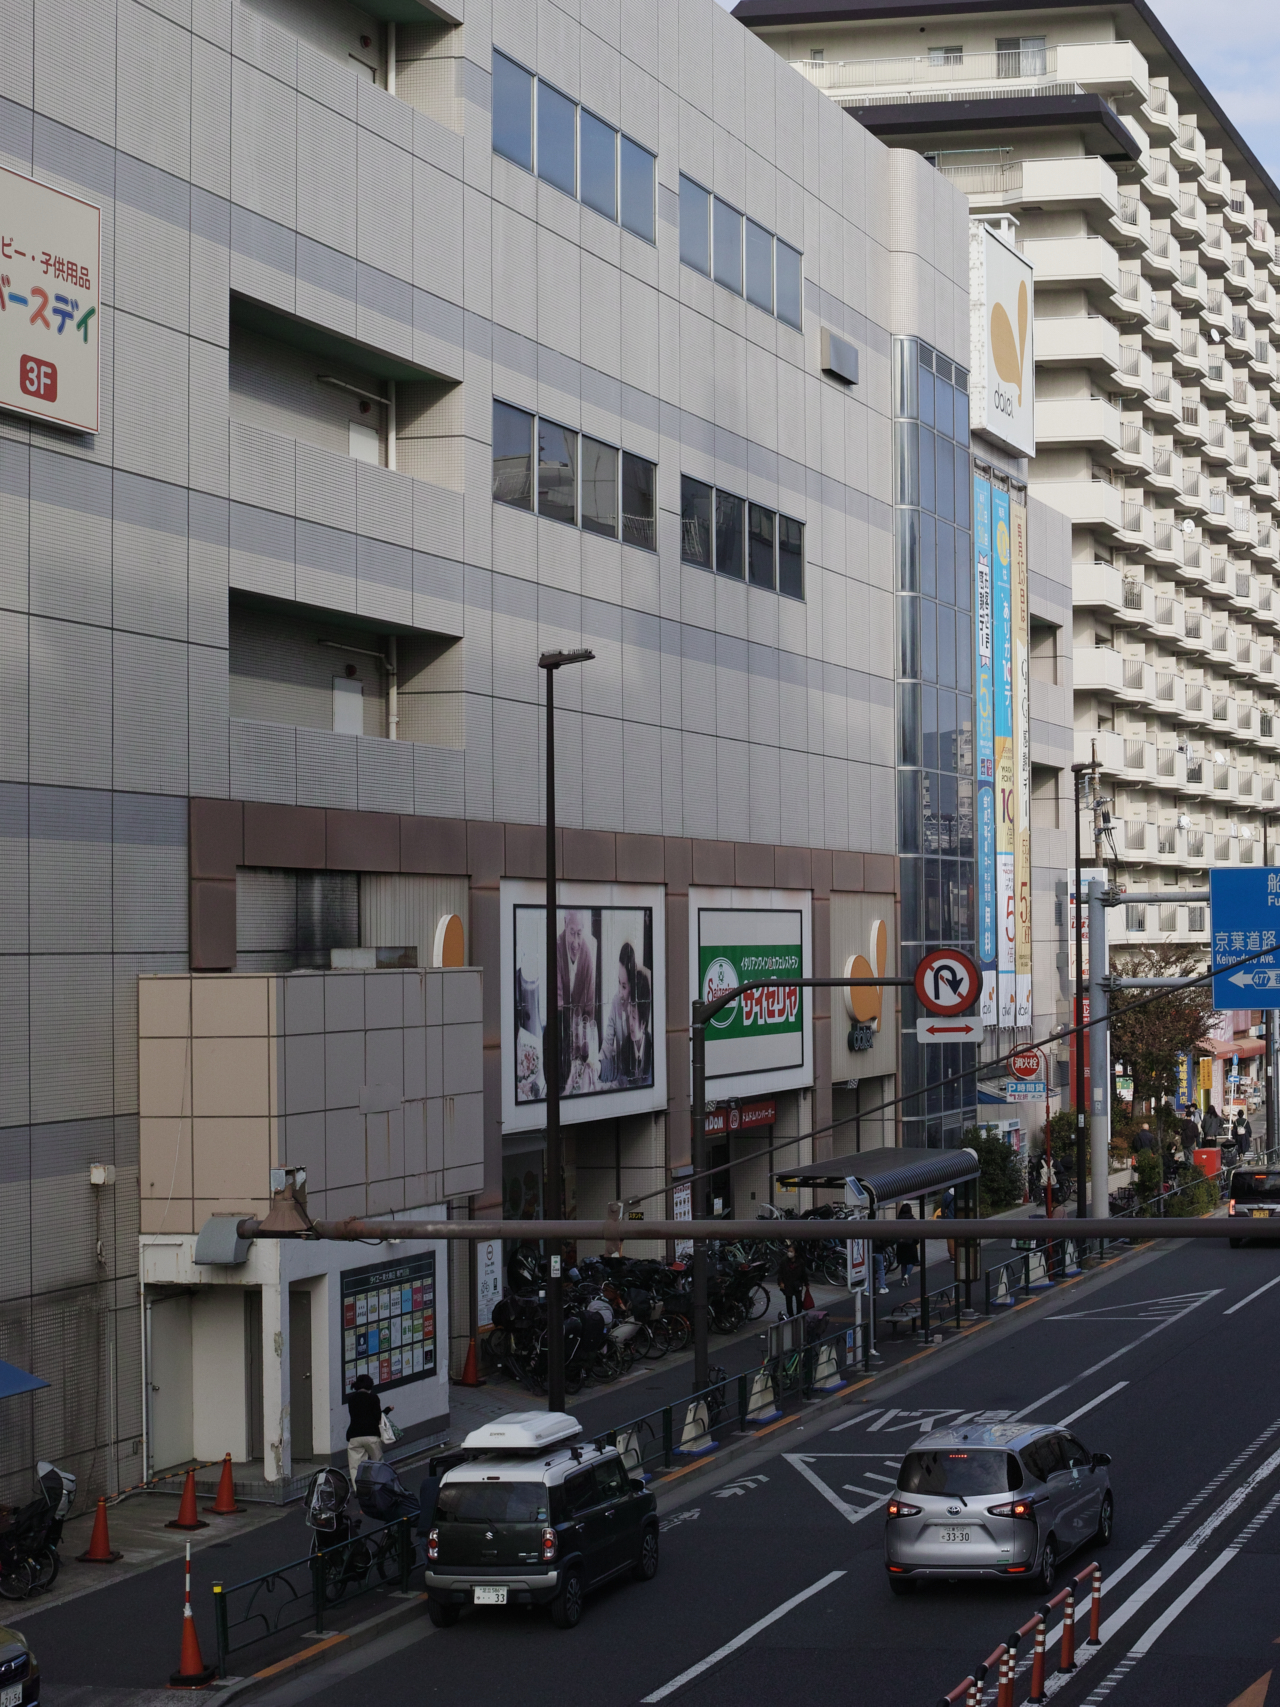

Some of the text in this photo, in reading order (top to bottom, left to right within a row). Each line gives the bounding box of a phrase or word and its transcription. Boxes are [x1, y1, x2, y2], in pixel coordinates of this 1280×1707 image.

[25, 361, 52, 395] 3F
[1214, 930, 1277, 952] 京葉道路
[1260, 953, 1276, 964] Ave.
[1253, 973, 1269, 984] 477
[1014, 1056, 1039, 1069] 消火栓
[742, 1108, 775, 1123] ドムドムハンバーガー
[946, 1532, 970, 1542] 33-30
[495, 1593, 506, 1603] 33
